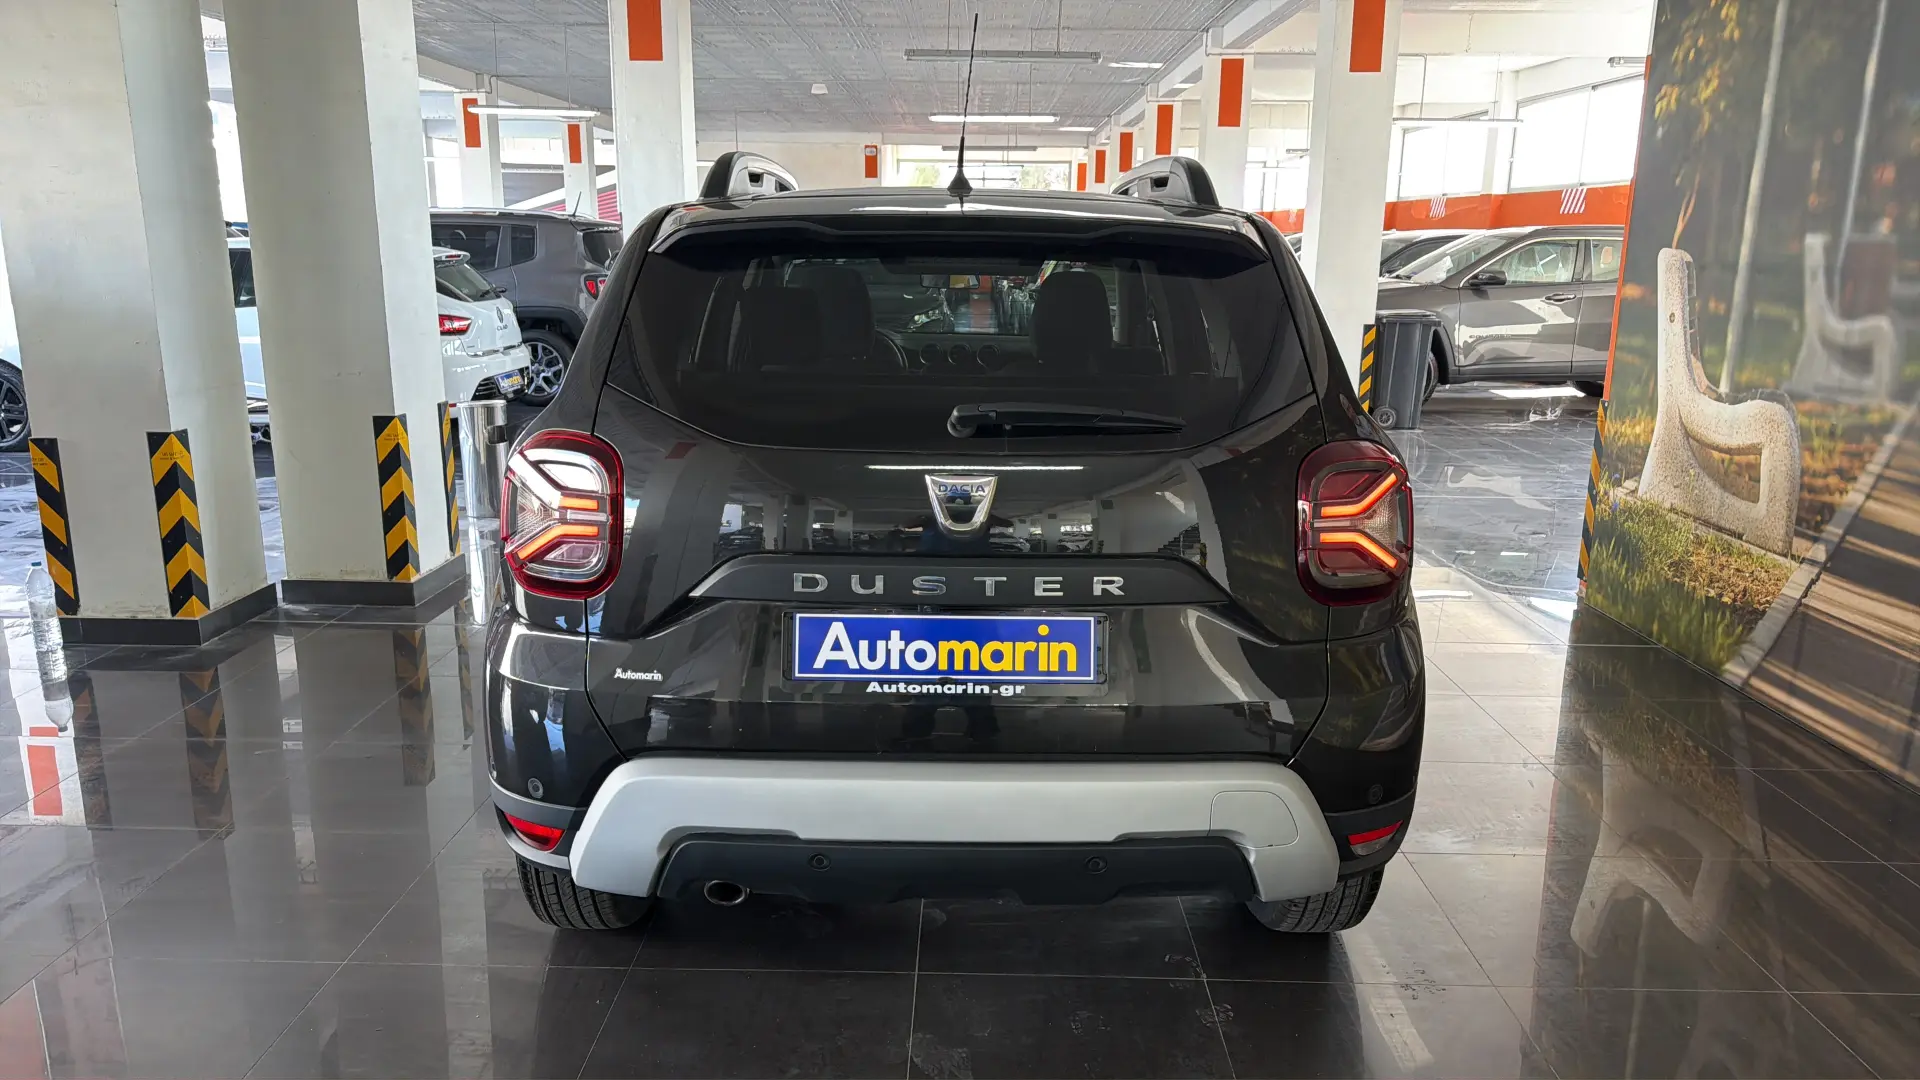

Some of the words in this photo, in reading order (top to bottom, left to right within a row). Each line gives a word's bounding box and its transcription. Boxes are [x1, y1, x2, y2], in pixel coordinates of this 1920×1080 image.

[938, 484, 986, 493] DACIA
[793, 573, 1125, 596] DUSTER
[813, 621, 1077, 671] Automarin
[614, 667, 663, 681] Automarin
[865, 681, 1025, 697] Automarin.gr
